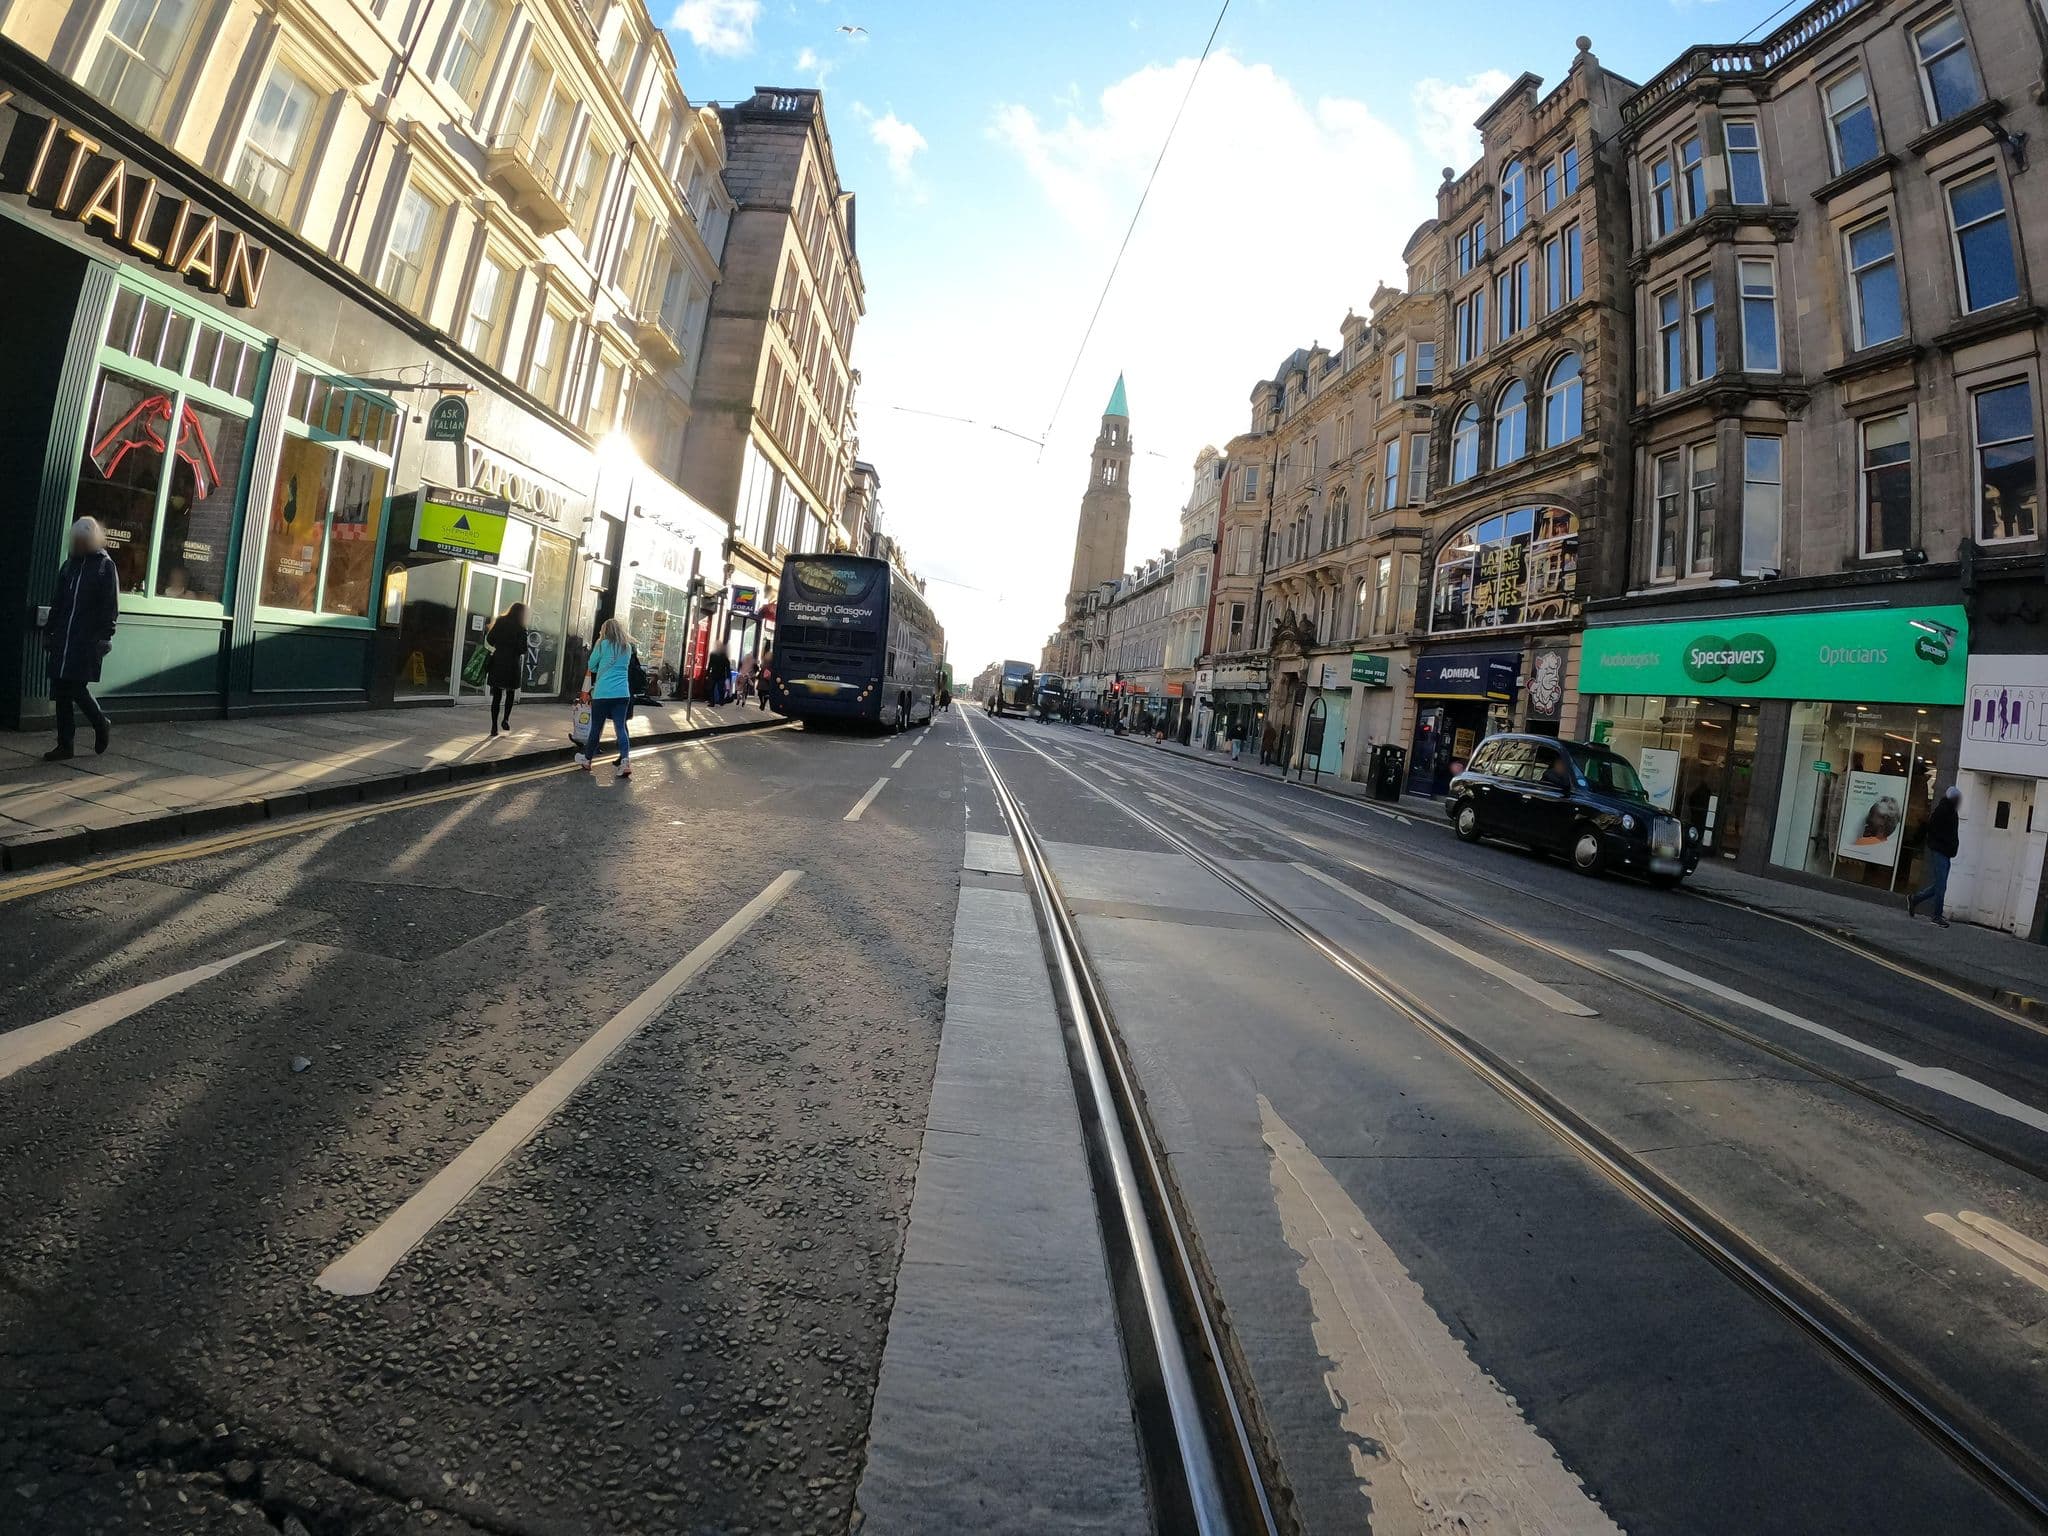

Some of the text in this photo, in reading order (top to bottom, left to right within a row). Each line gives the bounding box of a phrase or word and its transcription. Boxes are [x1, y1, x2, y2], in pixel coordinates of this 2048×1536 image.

[26, 116, 271, 309] ITALIAN
[440, 409, 458, 419] ASK
[431, 418, 465, 430] ITALIAN
[464, 442, 567, 522] VAPORONY
[450, 490, 487, 506] TO LET
[182, 552, 209, 562] LEMONADE
[280, 557, 304, 567] COCKTAIL
[1481, 544, 1522, 566] LATEST
[1480, 560, 1520, 577] MACINES
[732, 603, 754, 612] CORAL
[788, 602, 873, 618] Edinburgh Glasgow
[1600, 652, 1660, 669] Audiologists
[1690, 648, 1765, 669] Specsavers
[1819, 645, 1888, 667] Opticians
[1440, 666, 1481, 680] ADMIRAL
[1974, 688, 2048, 701] FANTASY
